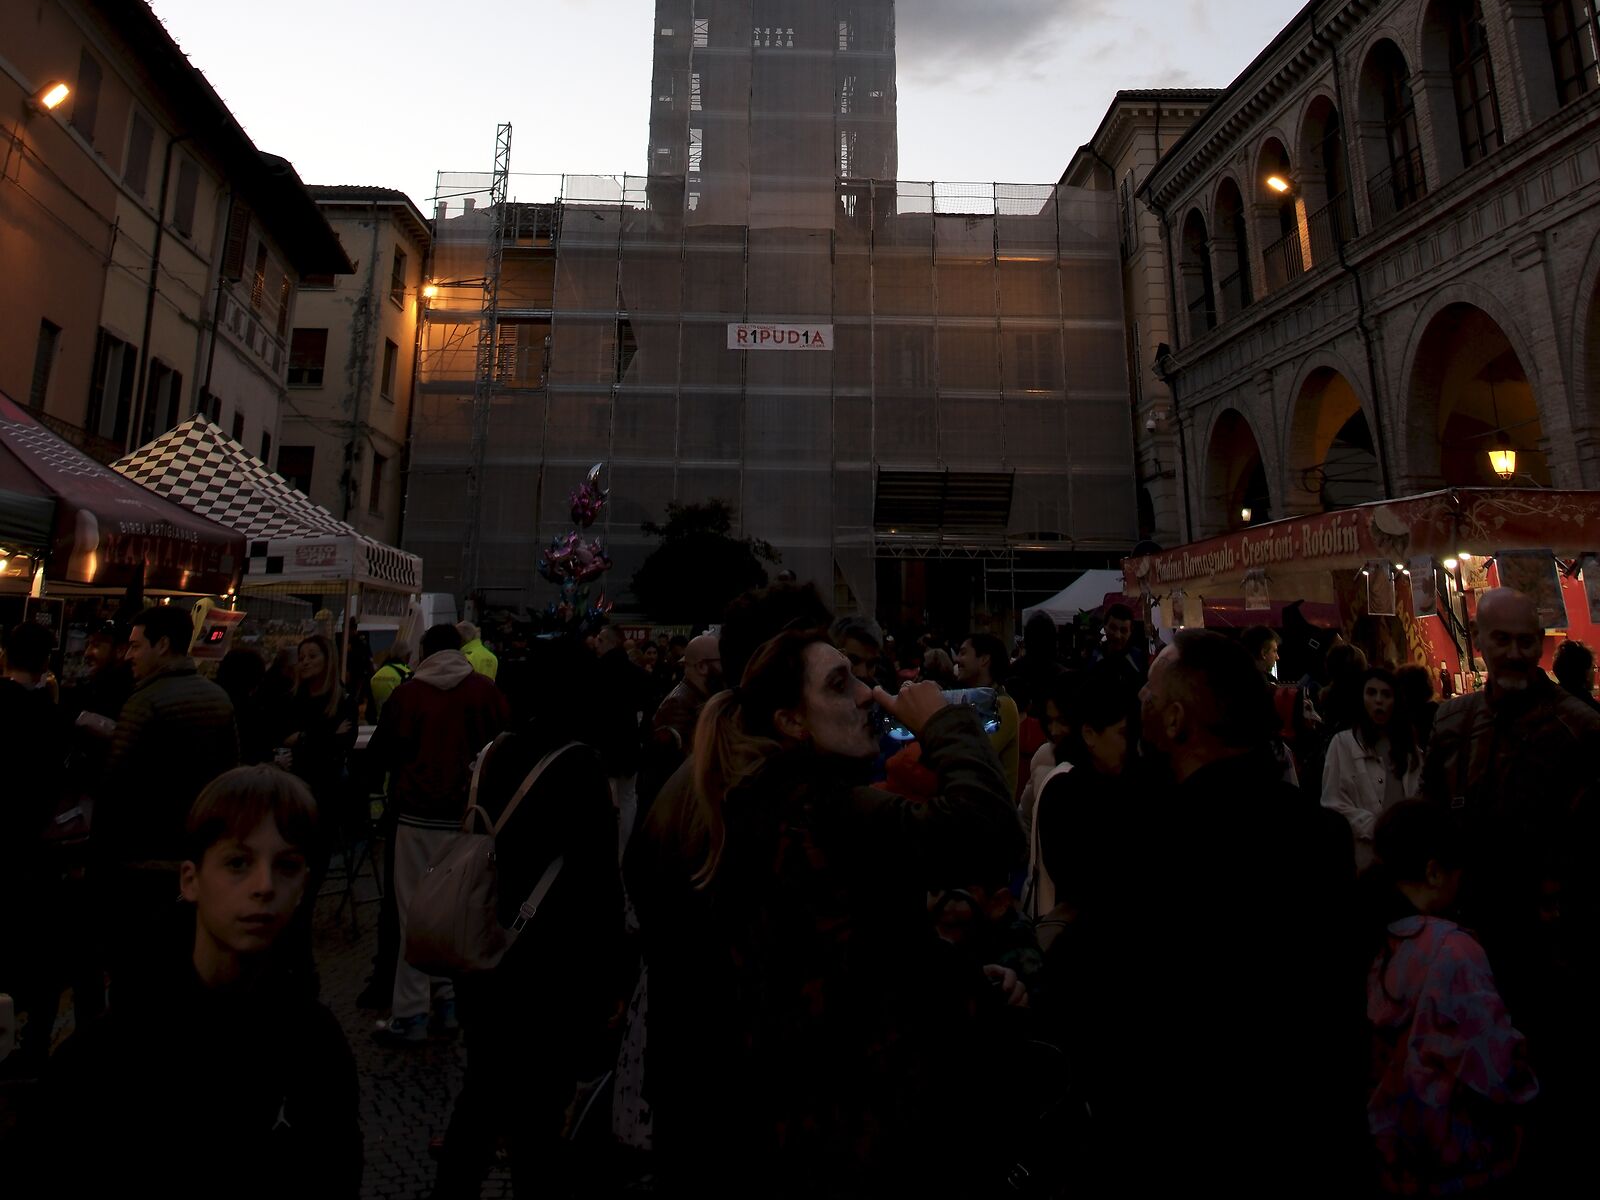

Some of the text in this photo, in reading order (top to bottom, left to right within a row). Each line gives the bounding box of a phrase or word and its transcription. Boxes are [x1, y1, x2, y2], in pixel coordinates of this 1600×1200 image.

[737, 330, 824, 344] R1PUD1A
[119, 521, 147, 536] BIRRA
[1155, 553, 1183, 583] Piadina
[1183, 541, 1235, 577] Romagnola
[1302, 513, 1360, 558] Rotolini
